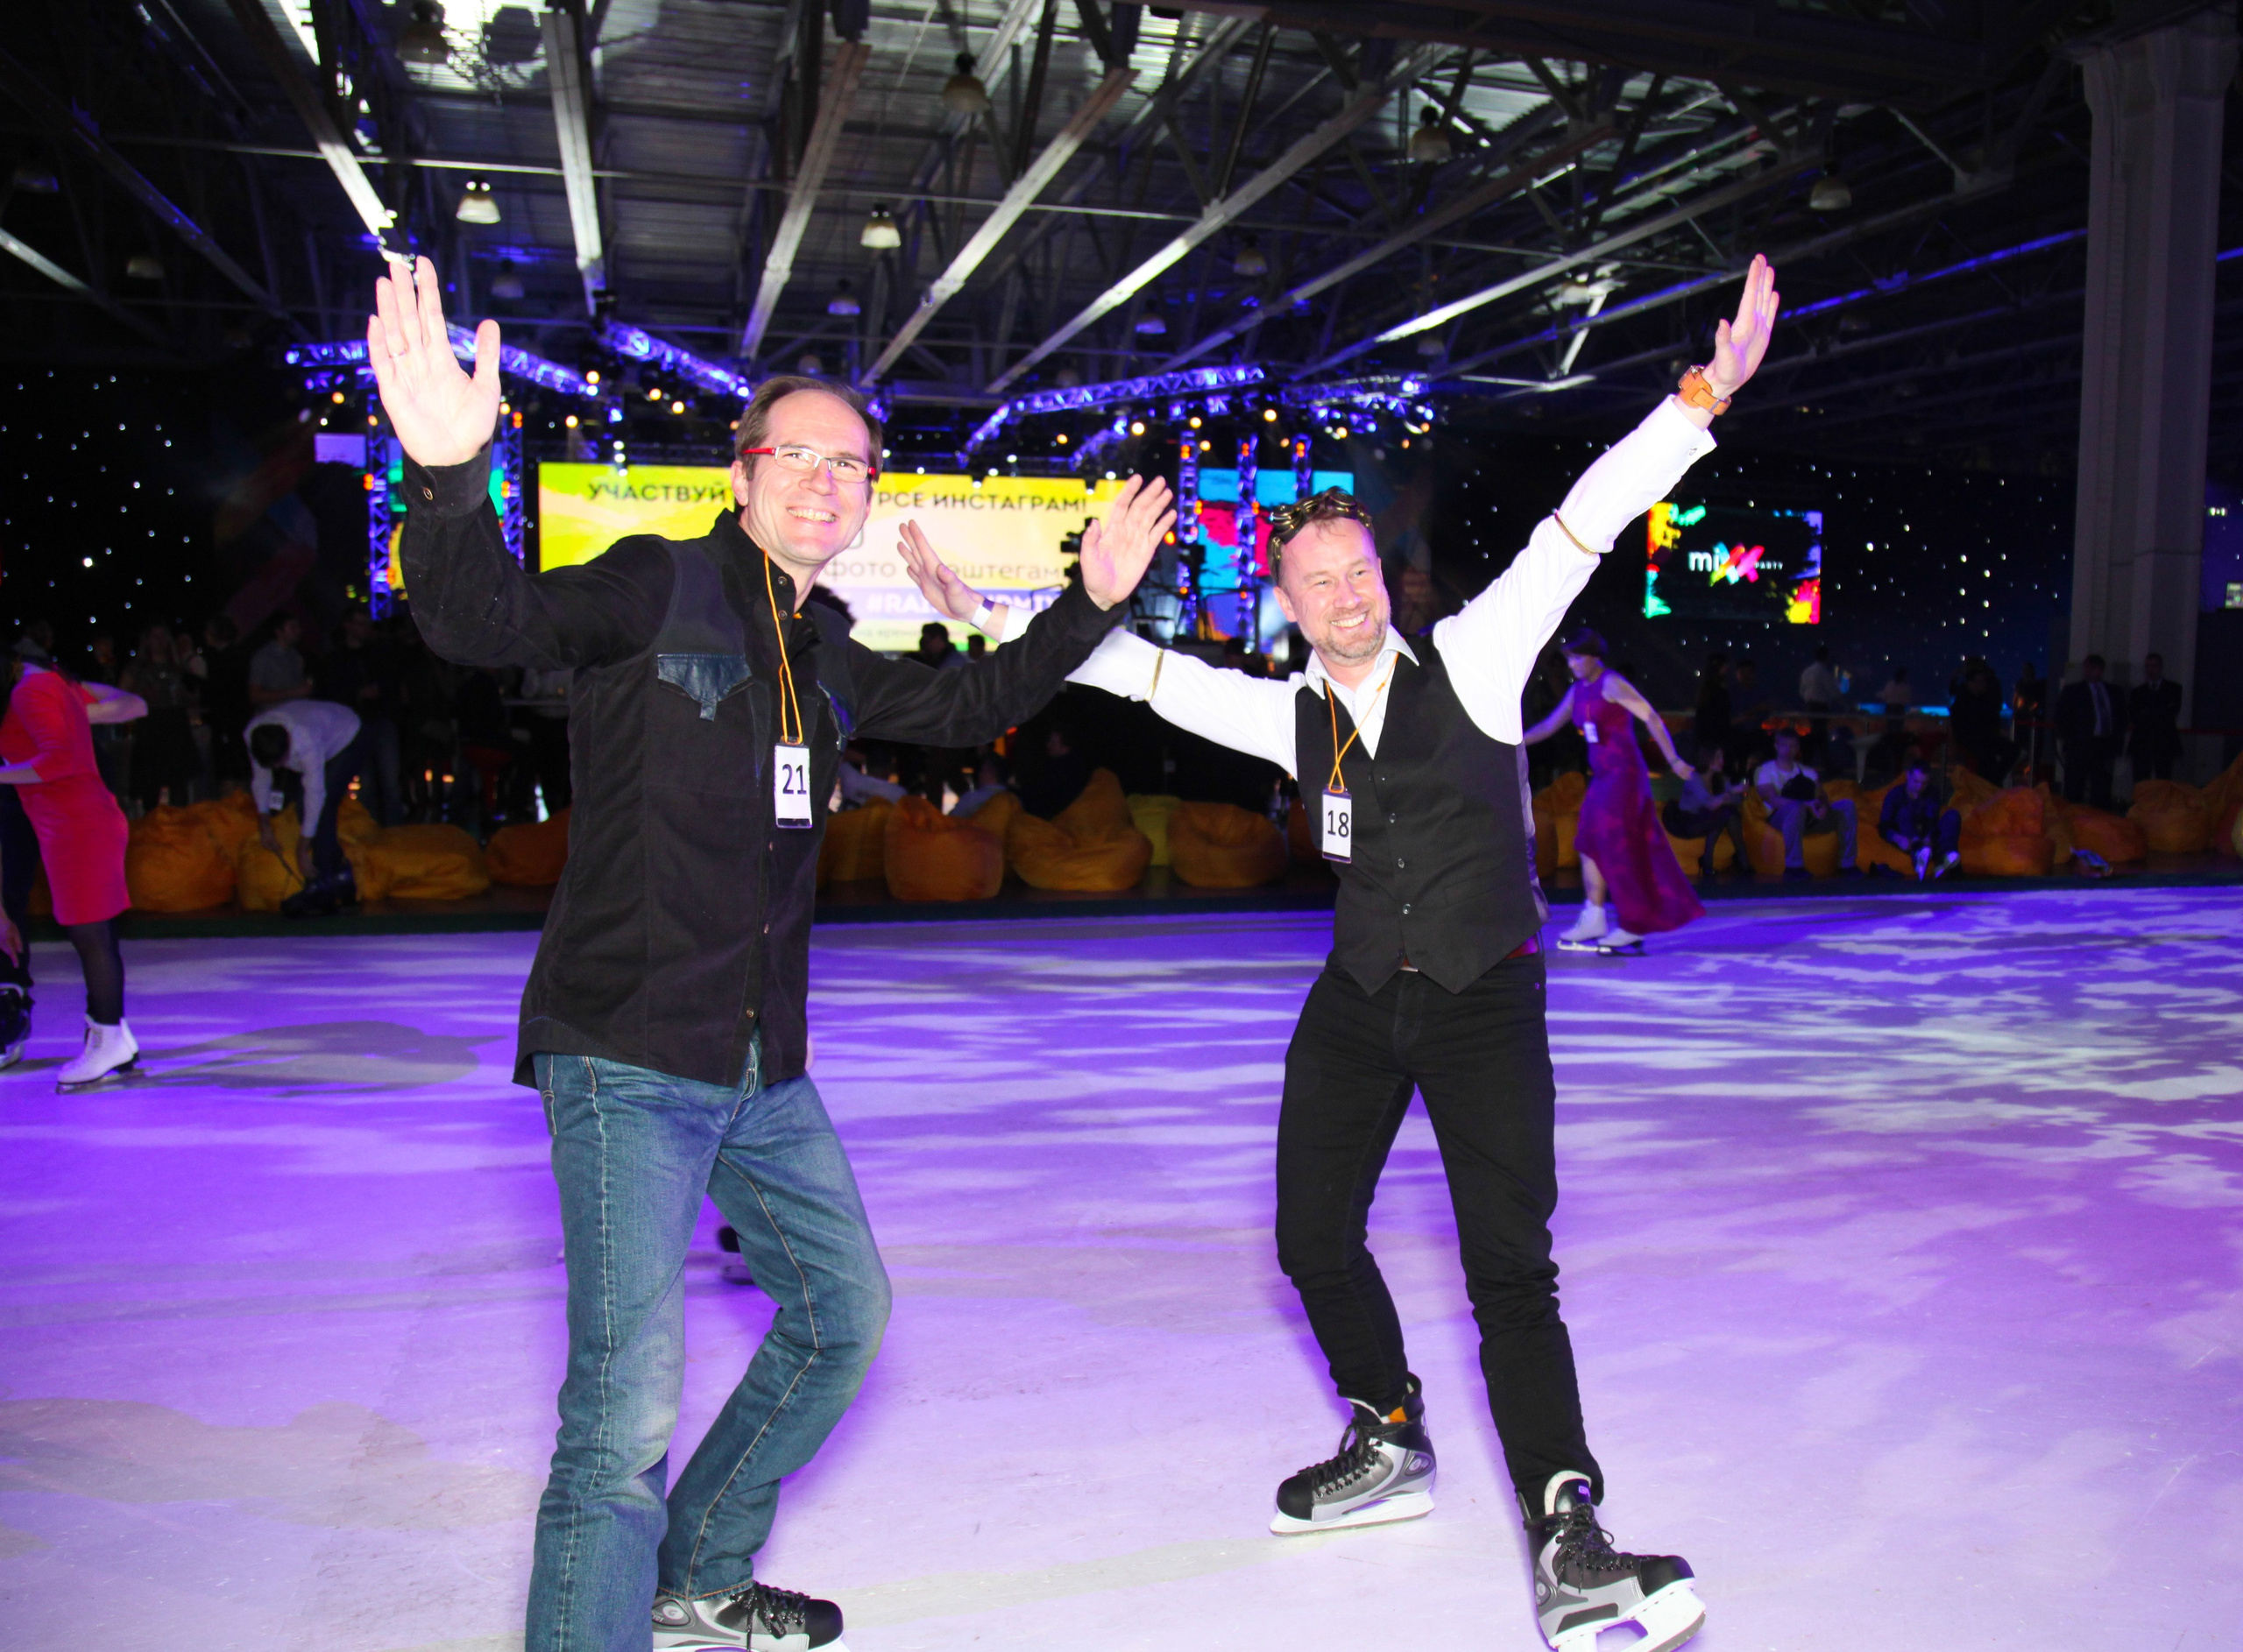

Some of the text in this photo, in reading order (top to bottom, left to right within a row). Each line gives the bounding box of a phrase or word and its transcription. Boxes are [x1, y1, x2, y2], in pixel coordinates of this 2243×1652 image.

[589, 481, 1086, 513] УЧАСТВУЙ РСЕ ИНСТАГРАМ!
[1755, 561, 1783, 570] PARTY
[782, 763, 807, 795] 21
[1327, 809, 1349, 838] 18
